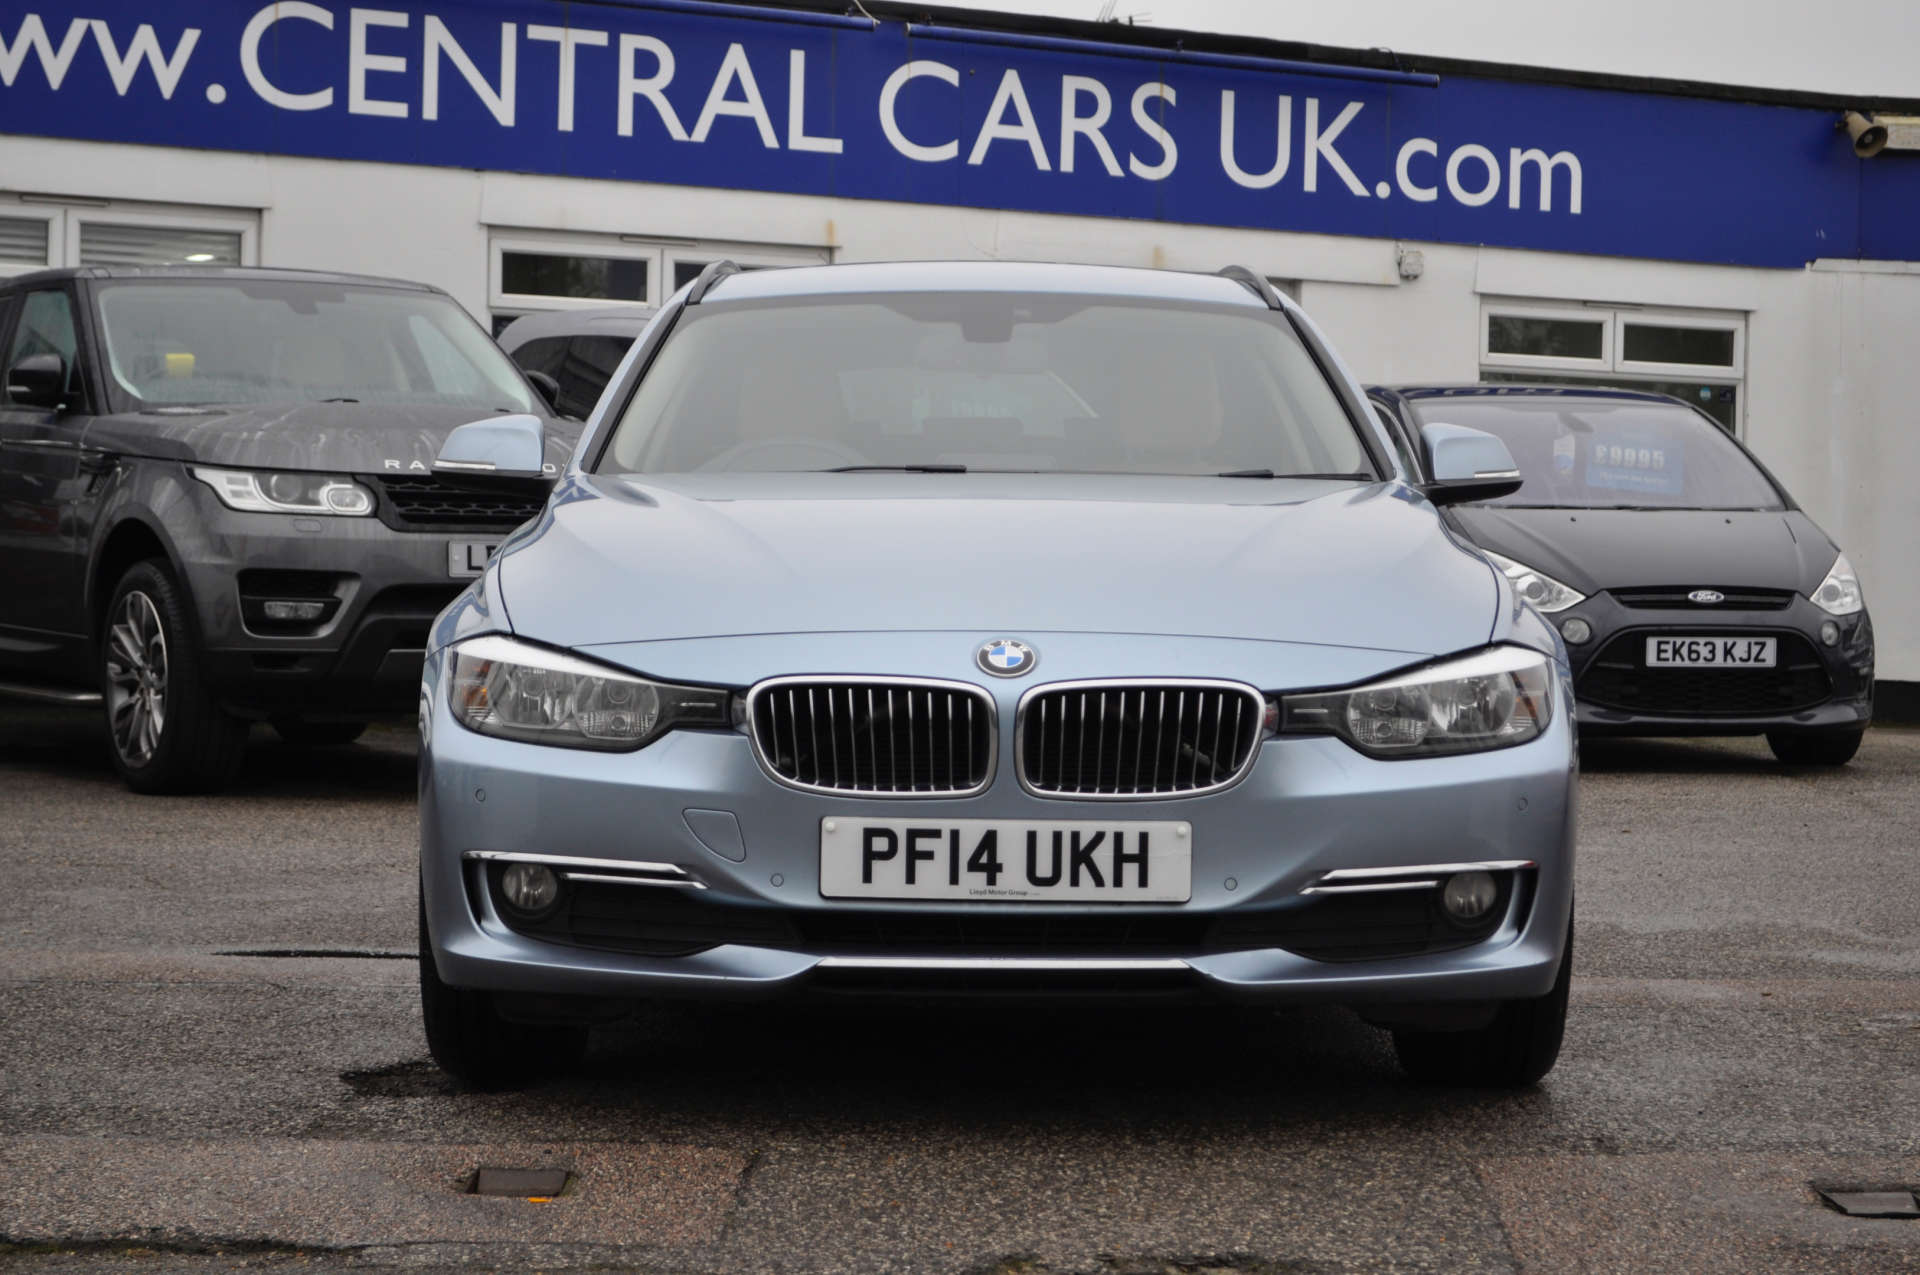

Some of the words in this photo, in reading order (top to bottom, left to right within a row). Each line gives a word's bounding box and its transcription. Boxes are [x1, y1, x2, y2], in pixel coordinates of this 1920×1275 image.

[879, 60, 1178, 181] CARS
[1220, 89, 1583, 214] UK.com
[1696, 591, 1717, 601] Ford
[1656, 640, 1716, 662] EK63
[1723, 641, 1767, 663] KJZ
[862, 827, 1003, 886] PF14
[1026, 830, 1149, 888] UKH
